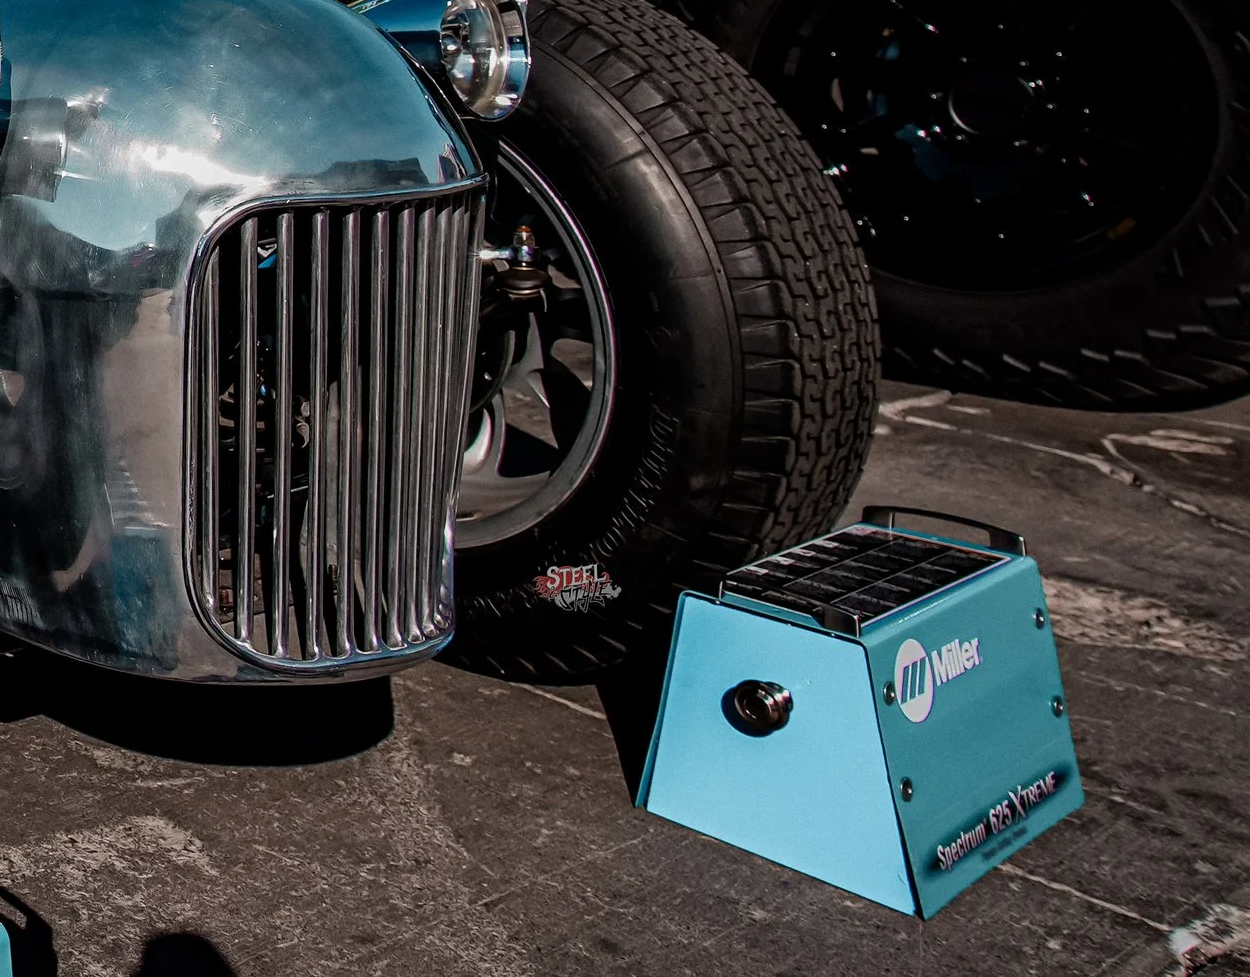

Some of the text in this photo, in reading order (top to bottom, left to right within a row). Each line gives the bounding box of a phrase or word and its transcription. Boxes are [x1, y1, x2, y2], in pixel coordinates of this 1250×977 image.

[546, 563, 607, 589] STEEL
[930, 637, 981, 687] Miller
[989, 800, 1013, 834] 625
